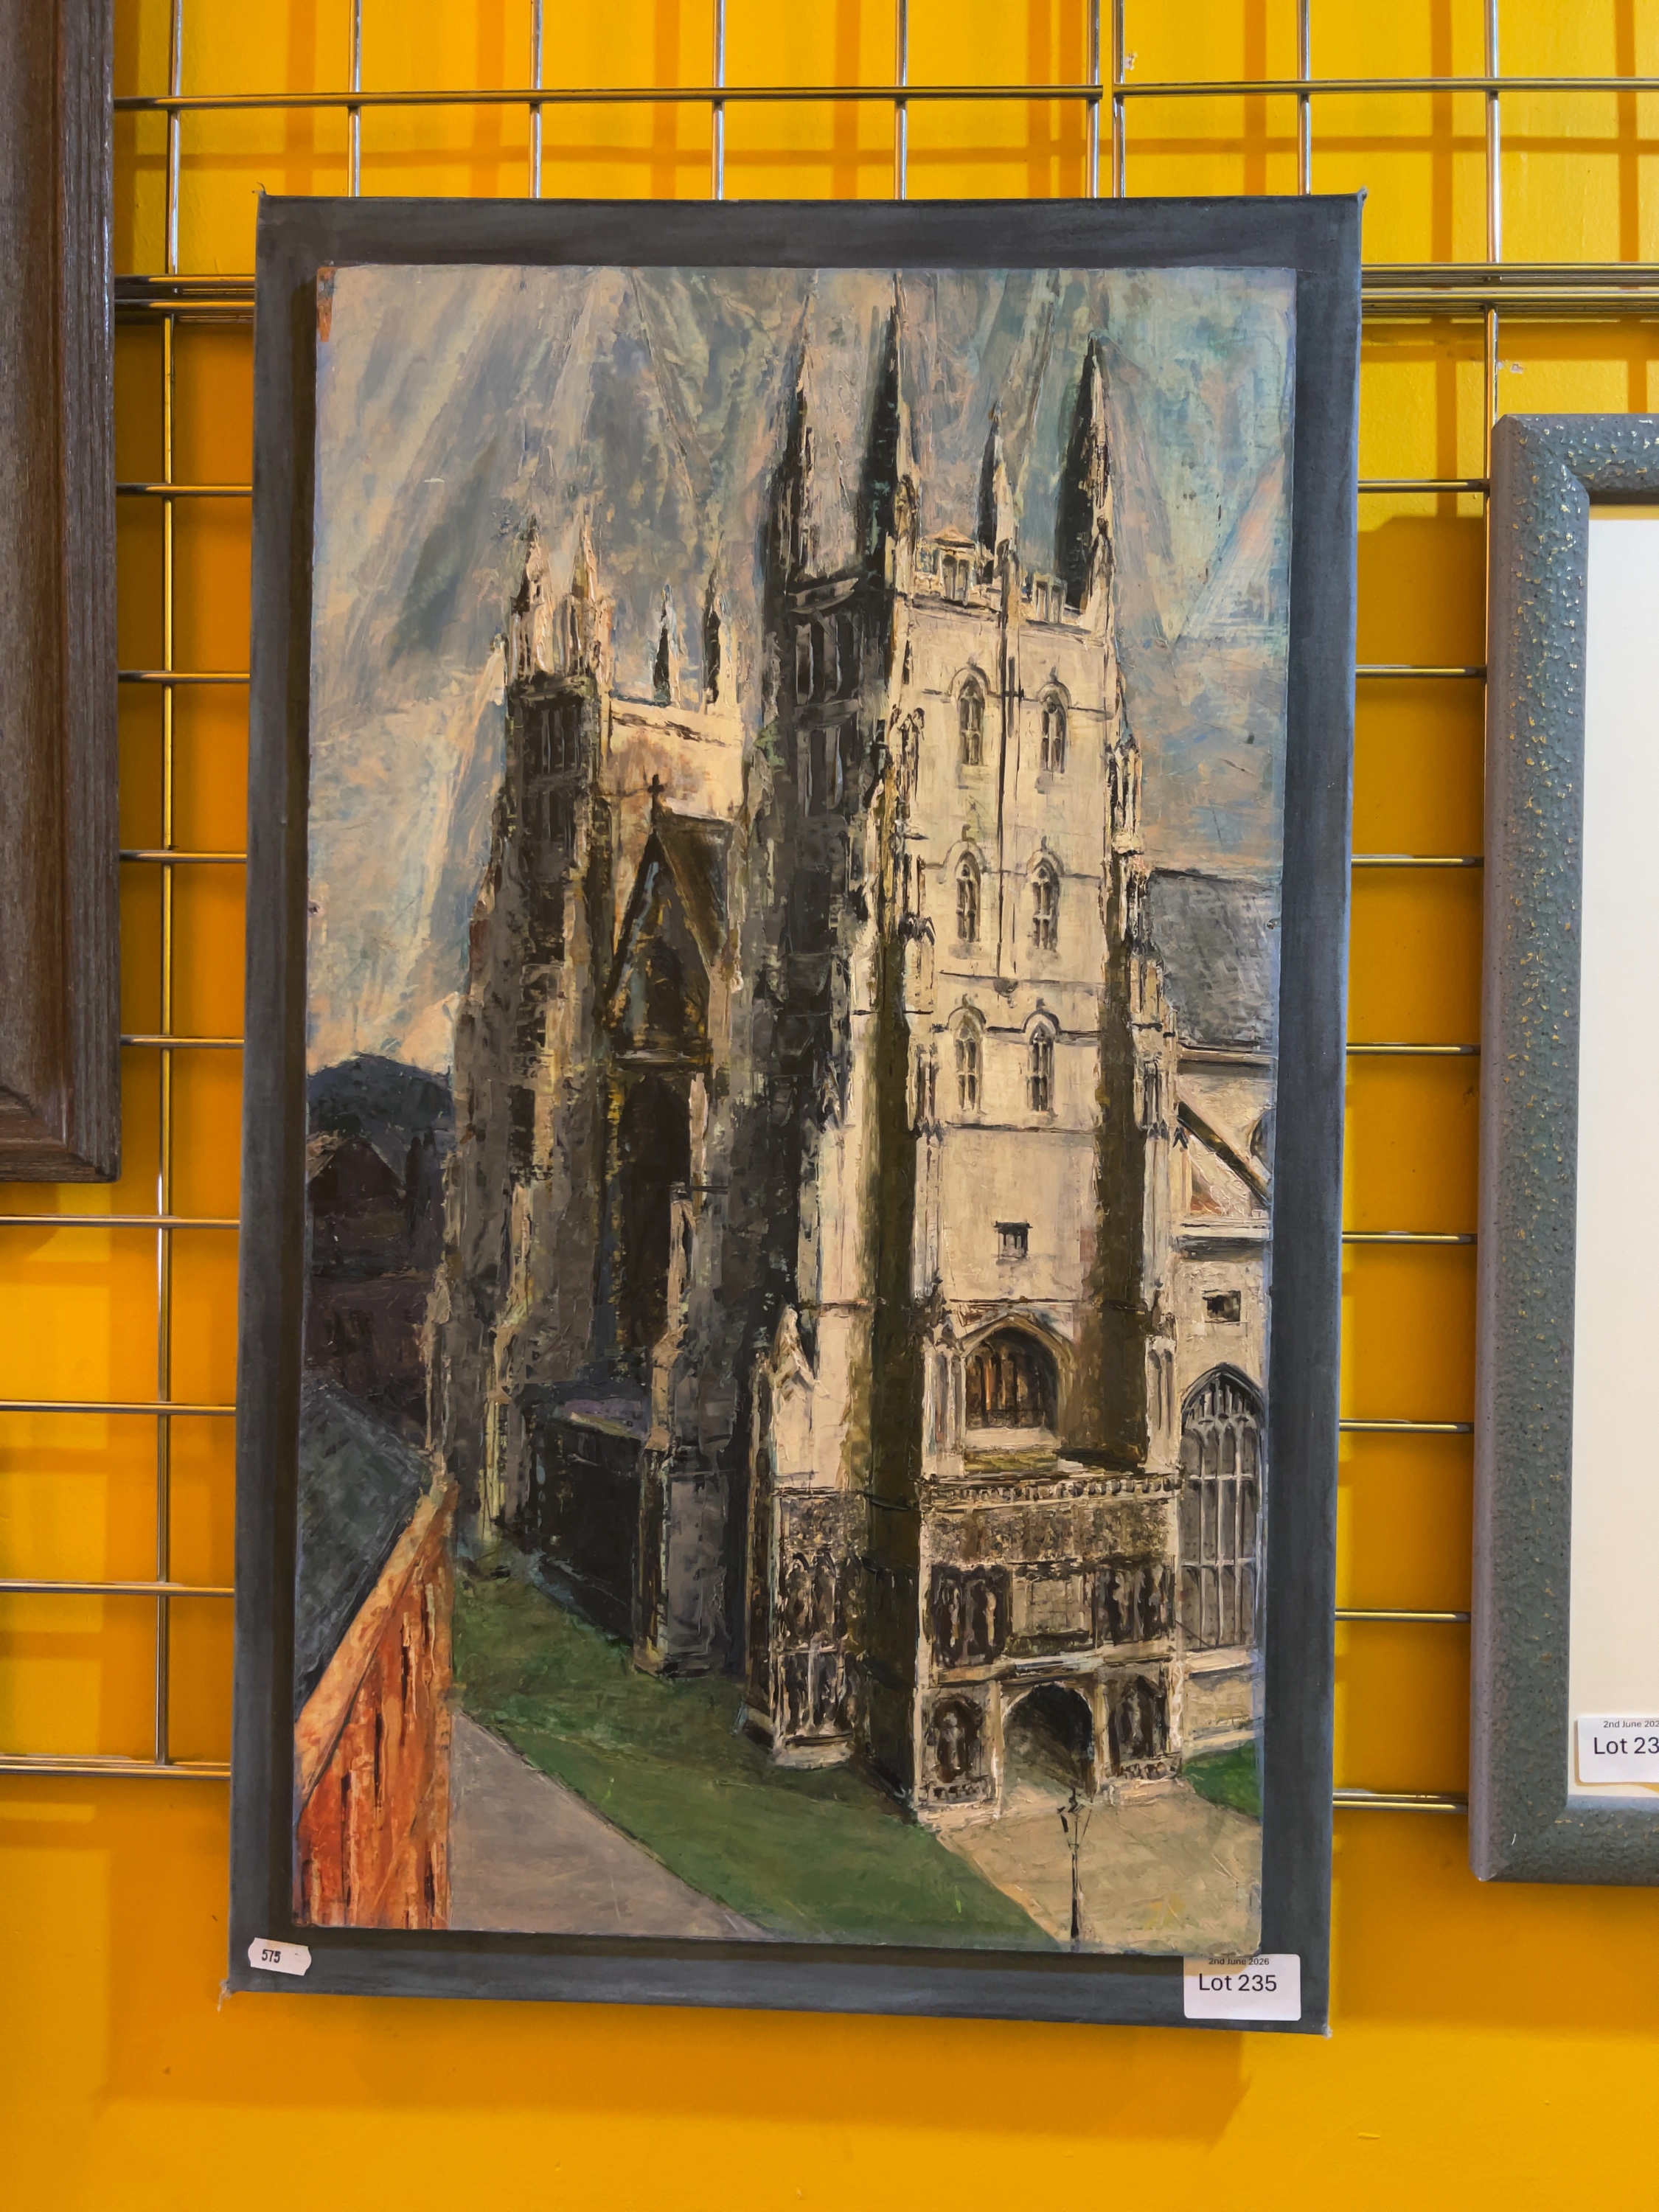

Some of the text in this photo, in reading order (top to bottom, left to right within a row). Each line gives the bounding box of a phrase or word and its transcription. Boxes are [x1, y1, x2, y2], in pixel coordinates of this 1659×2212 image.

[1594, 1737, 1628, 1754] Lot
[262, 1949, 282, 1964] 575
[1199, 1973, 1277, 1992] Lot 235
